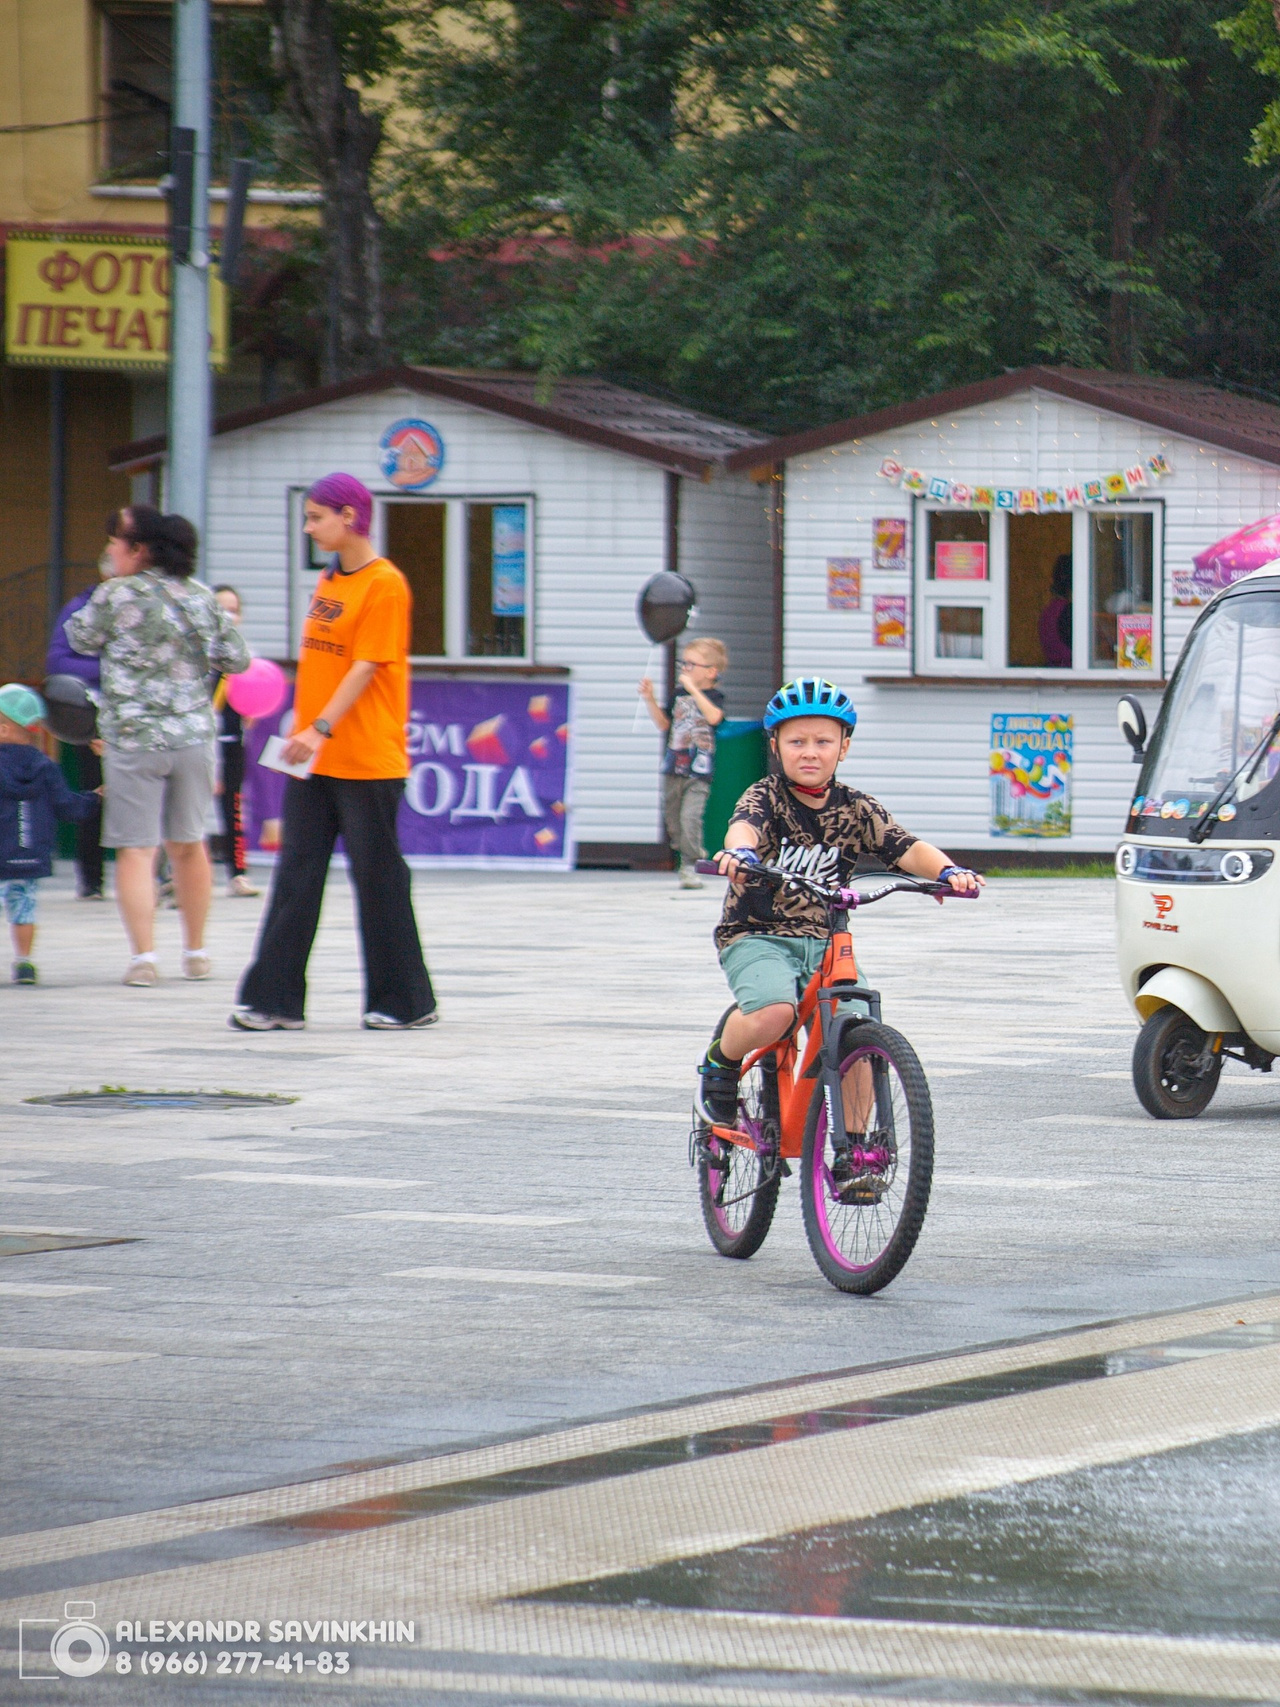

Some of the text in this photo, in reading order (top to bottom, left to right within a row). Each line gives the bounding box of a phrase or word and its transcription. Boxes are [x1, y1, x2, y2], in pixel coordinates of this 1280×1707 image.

[13, 303, 212, 350] ПЕЧА
[404, 709, 466, 757] ём
[993, 715, 1004, 731] С
[993, 731, 1072, 750] ГОРОДА!
[404, 761, 547, 825] ОДА
